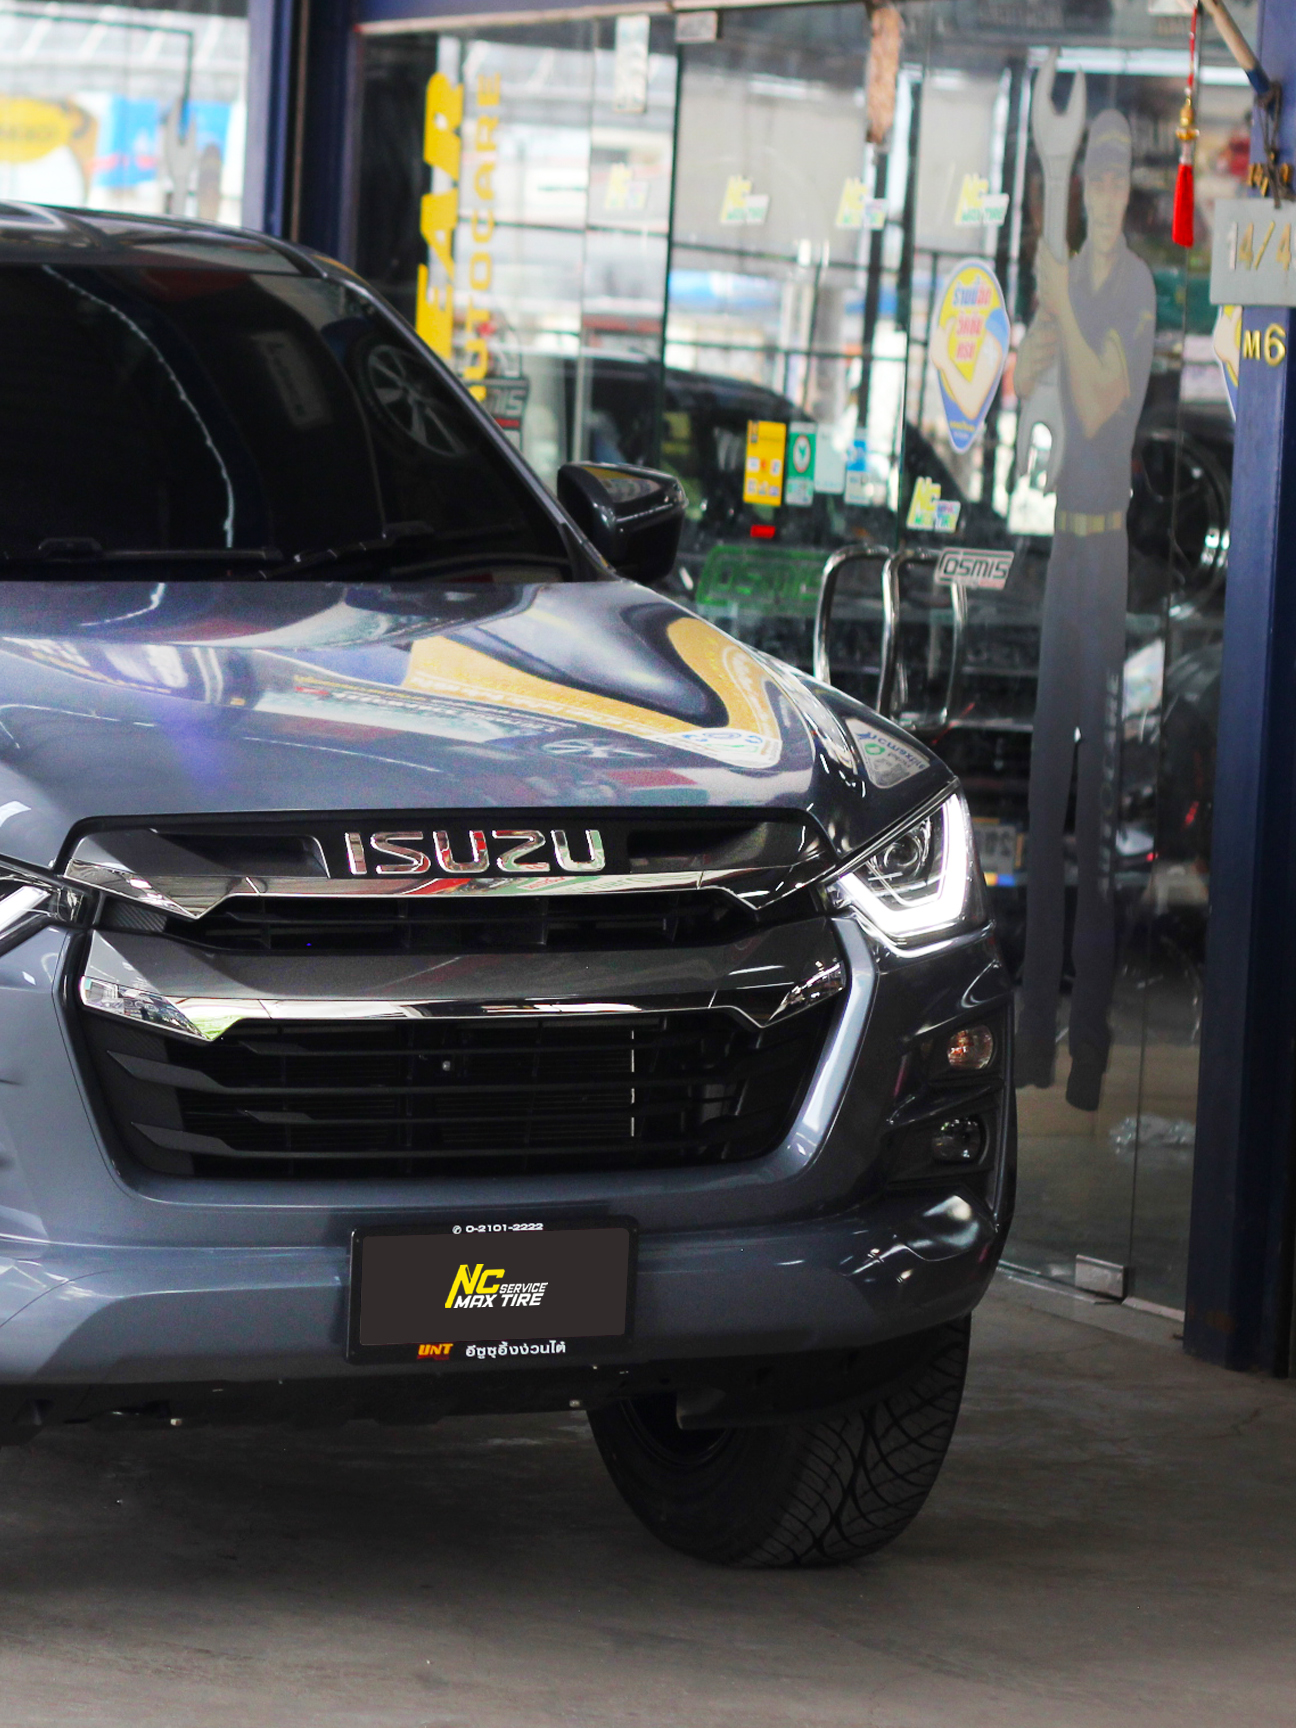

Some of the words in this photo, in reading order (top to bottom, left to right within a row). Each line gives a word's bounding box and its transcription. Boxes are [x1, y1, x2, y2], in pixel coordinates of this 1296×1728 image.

[1227, 220, 1296, 271] 14/4
[1242, 322, 1287, 367] M6
[344, 829, 606, 875] ISUZU
[465, 1222, 544, 1234] 0-2101-2222
[418, 1342, 454, 1356] UNT
